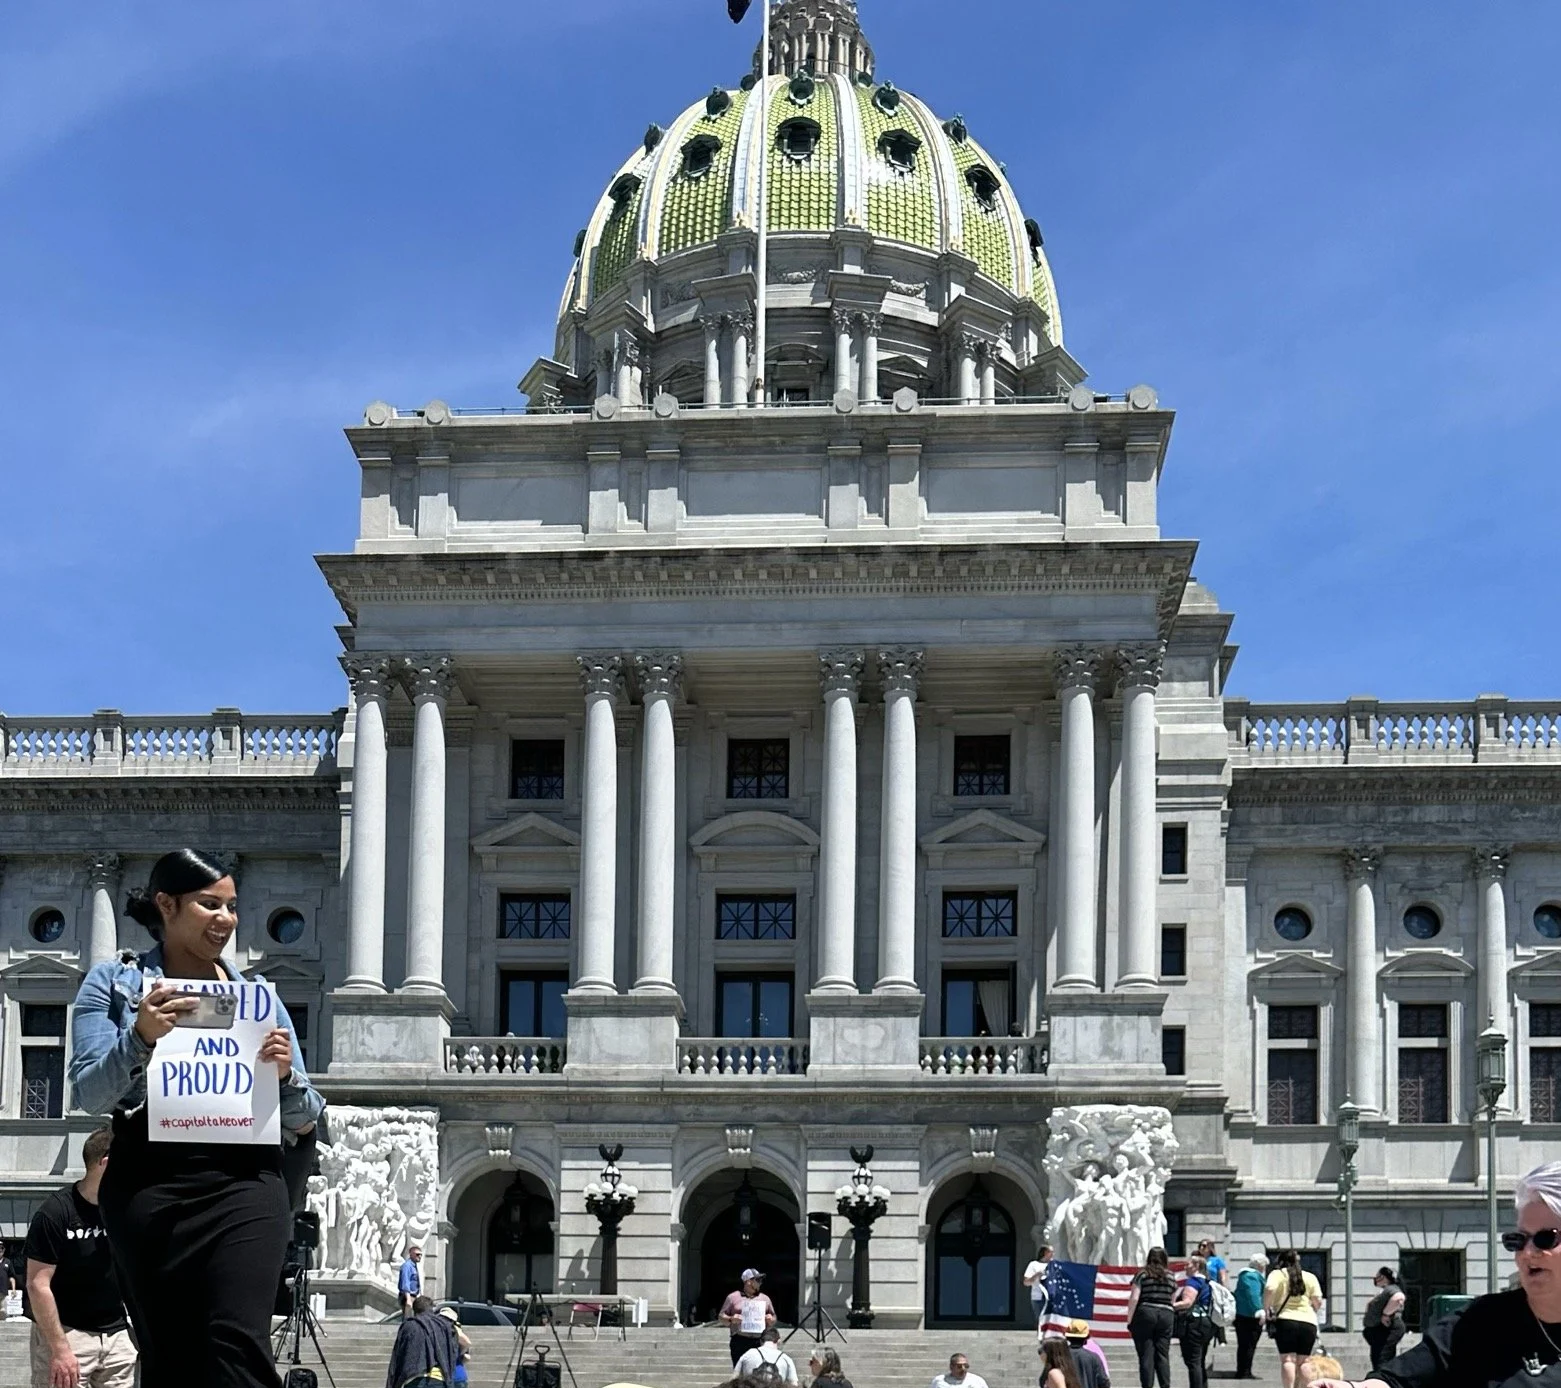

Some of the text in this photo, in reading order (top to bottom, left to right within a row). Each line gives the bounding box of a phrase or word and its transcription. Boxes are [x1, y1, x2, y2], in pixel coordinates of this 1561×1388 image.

[194, 1037, 239, 1057] AND
[162, 1061, 253, 1097] PROUD
[160, 1116, 255, 1130] #capitoltakeover
